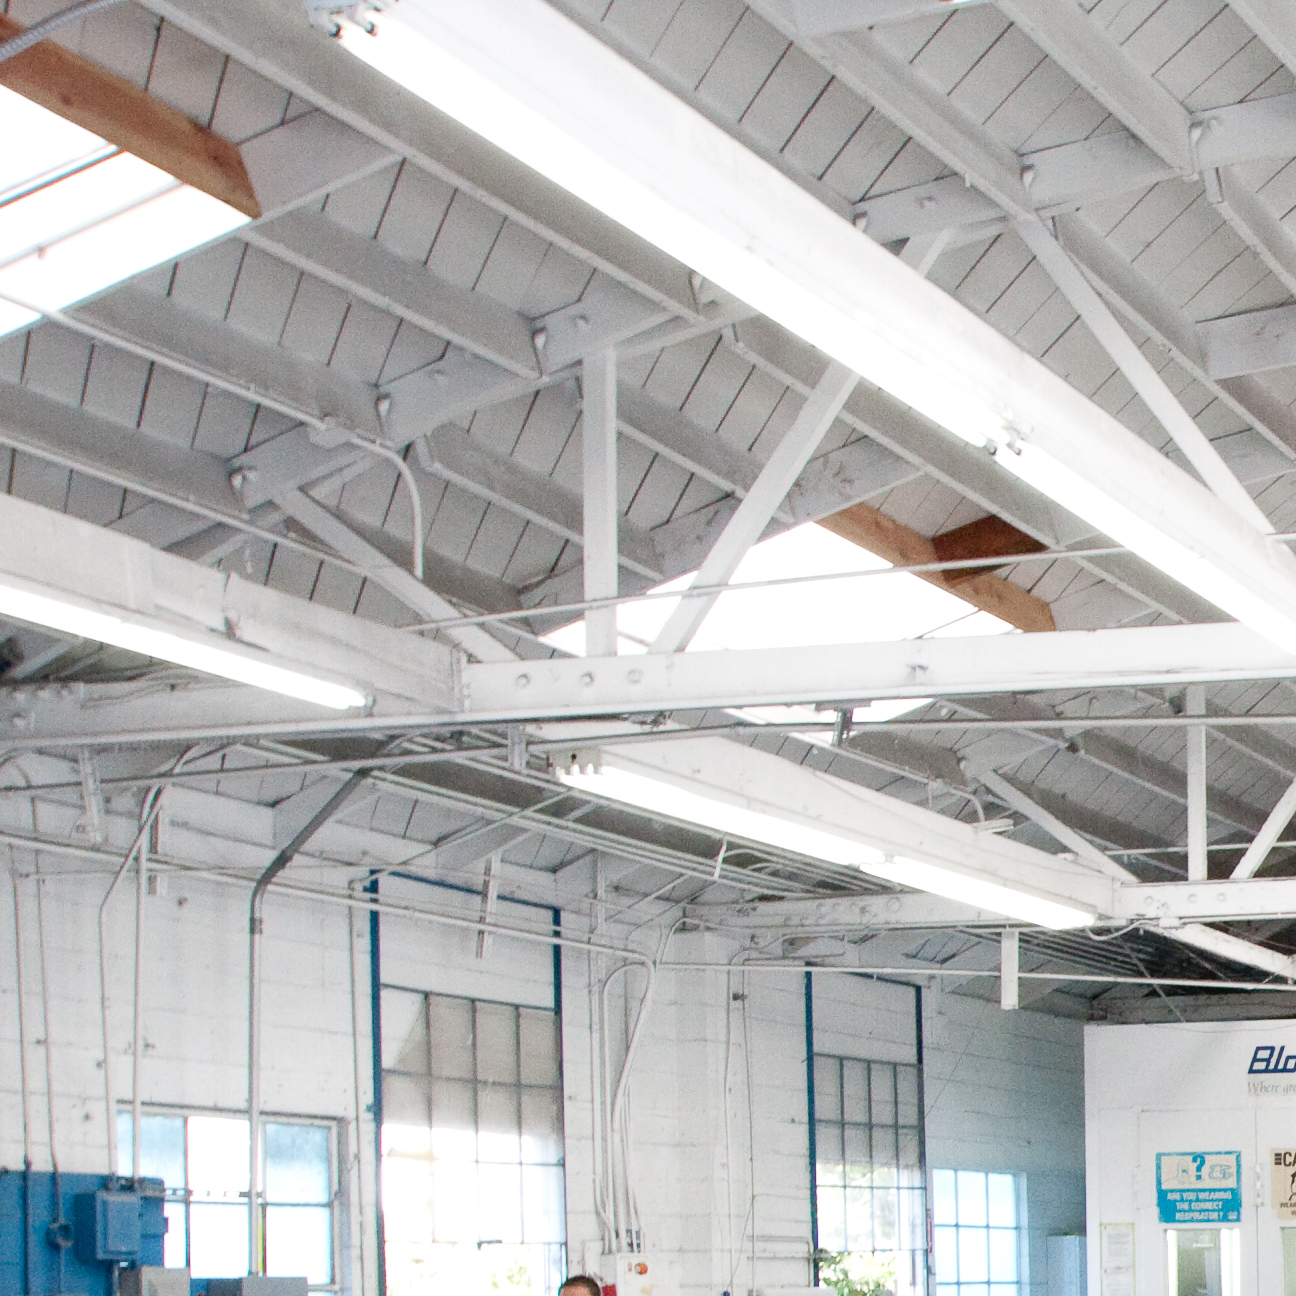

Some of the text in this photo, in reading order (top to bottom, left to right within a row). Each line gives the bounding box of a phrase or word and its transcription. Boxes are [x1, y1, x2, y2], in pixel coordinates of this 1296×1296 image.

[1247, 1081, 1280, 1094] Where
[1182, 1191, 1196, 1200] YOU
[1176, 1202, 1189, 1210] THE
